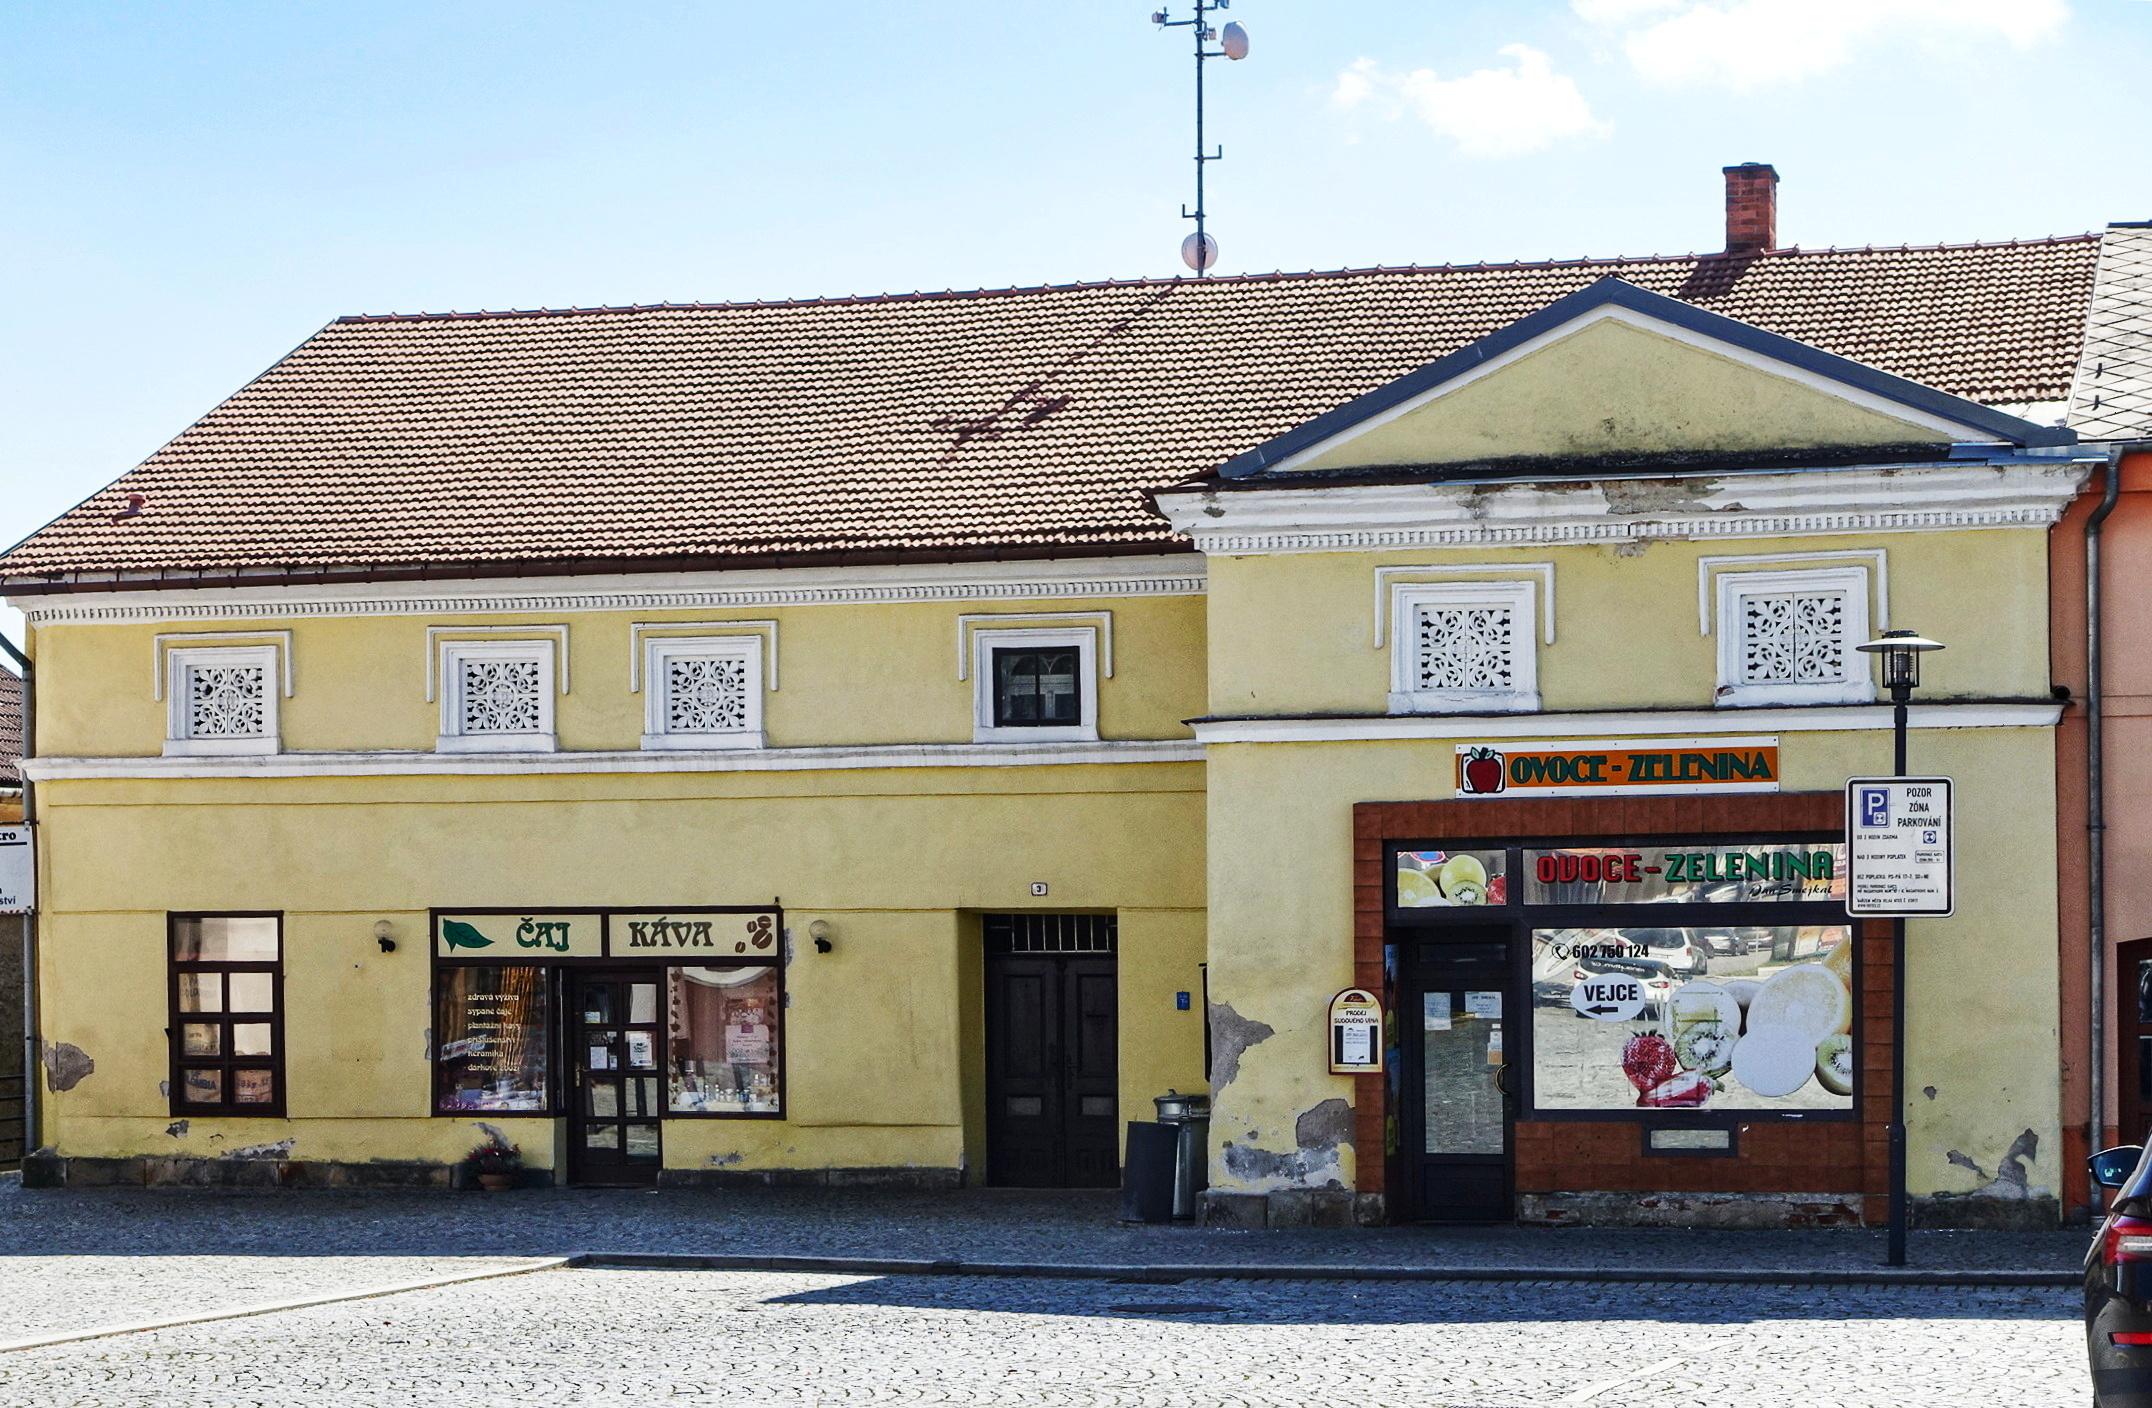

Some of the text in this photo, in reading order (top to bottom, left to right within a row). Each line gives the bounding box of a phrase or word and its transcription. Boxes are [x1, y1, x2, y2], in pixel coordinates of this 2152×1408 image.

[1510, 755, 1607, 785] OVOCE
[1628, 751, 1774, 783] ZELENINA
[1906, 787, 1932, 798] POZOR
[1908, 800, 1930, 812] ZÓNA
[1897, 815, 1942, 828] PARKOVÁNÍ
[1036, 885, 1042, 893] 3
[1749, 883, 1833, 898] Jan Smejkal
[515, 917, 571, 952] ČAJ
[629, 916, 715, 948] KÁVA
[1572, 943, 1650, 959] 602 750 124
[467, 993, 494, 1001] zdravá
[1583, 984, 1638, 1001] VEJCE
[467, 1007, 513, 1016] sypané čaje
[467, 1049, 504, 1057] keramika
